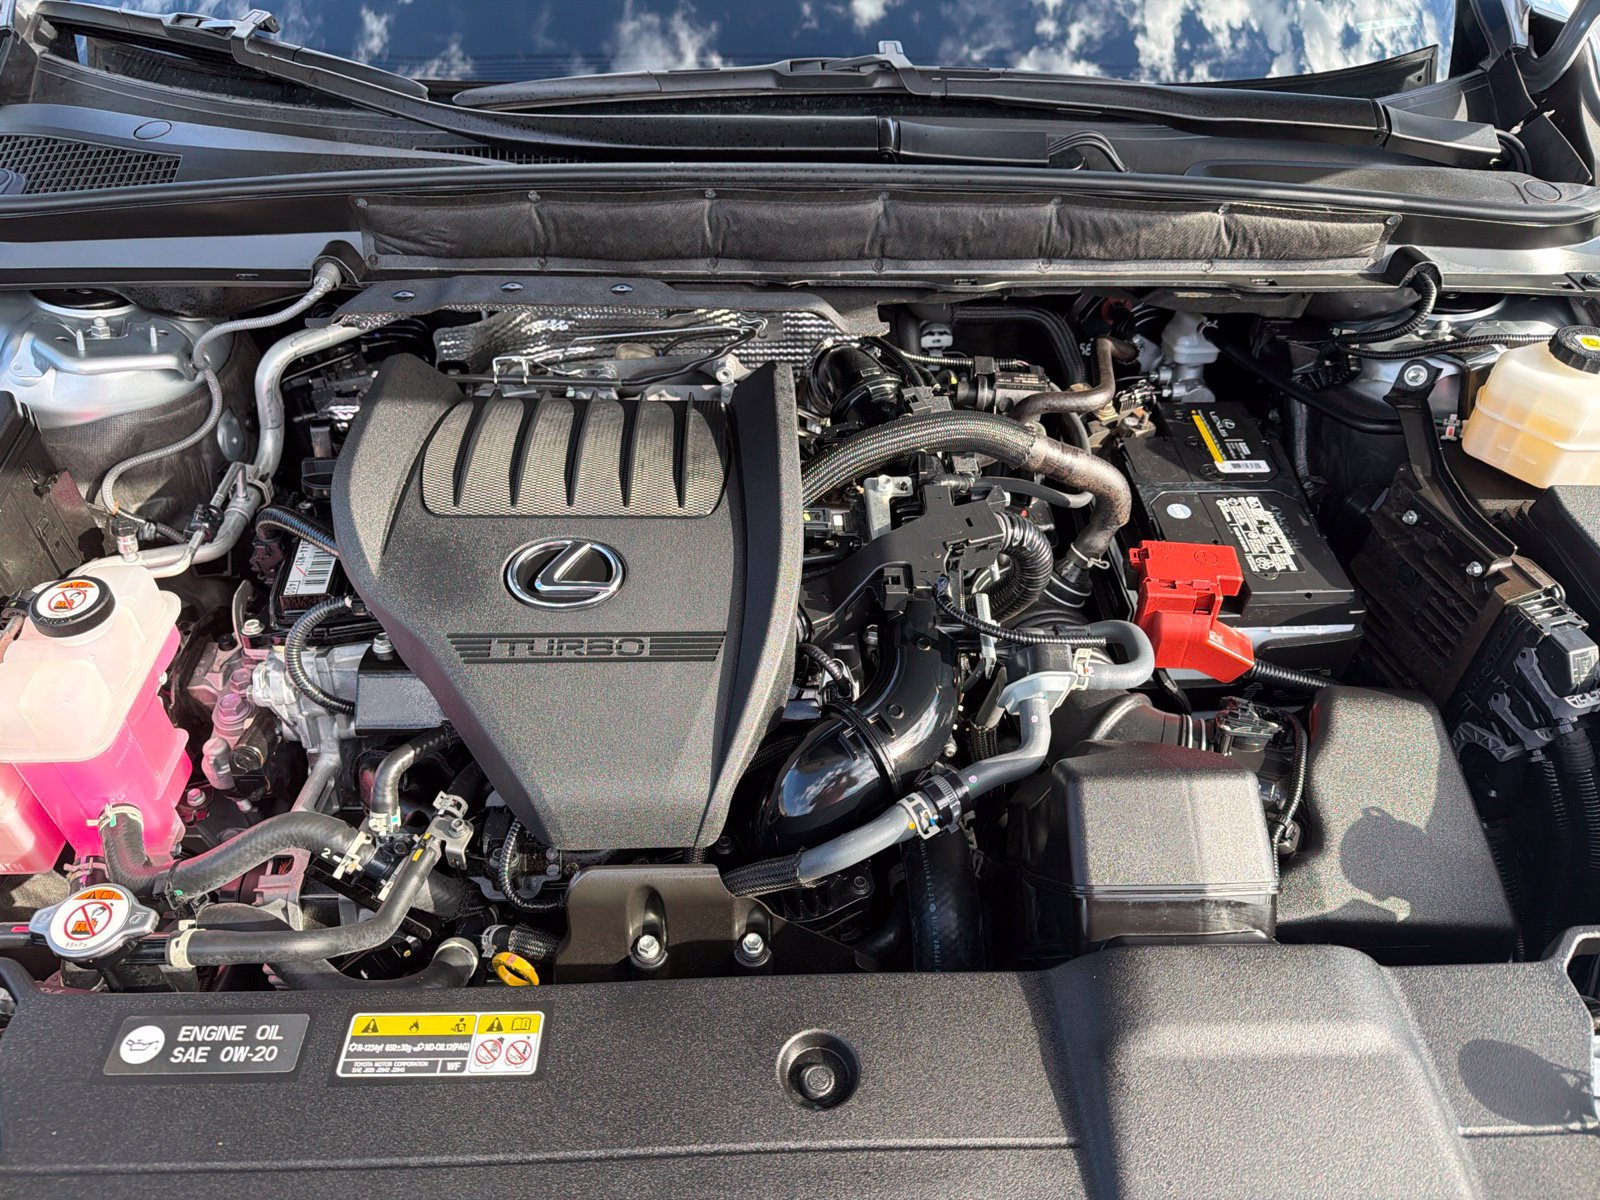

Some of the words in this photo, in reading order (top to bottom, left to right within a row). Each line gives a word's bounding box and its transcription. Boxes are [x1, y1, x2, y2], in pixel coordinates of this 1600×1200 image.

[1209, 411, 1229, 438] LEXUS
[492, 637, 646, 658] TURBO
[320, 847, 331, 858] 2
[177, 1025, 247, 1041] ENGINE
[256, 1025, 284, 1040] OIL
[169, 1046, 211, 1063] SAE
[220, 1046, 278, 1062] 0W-20
